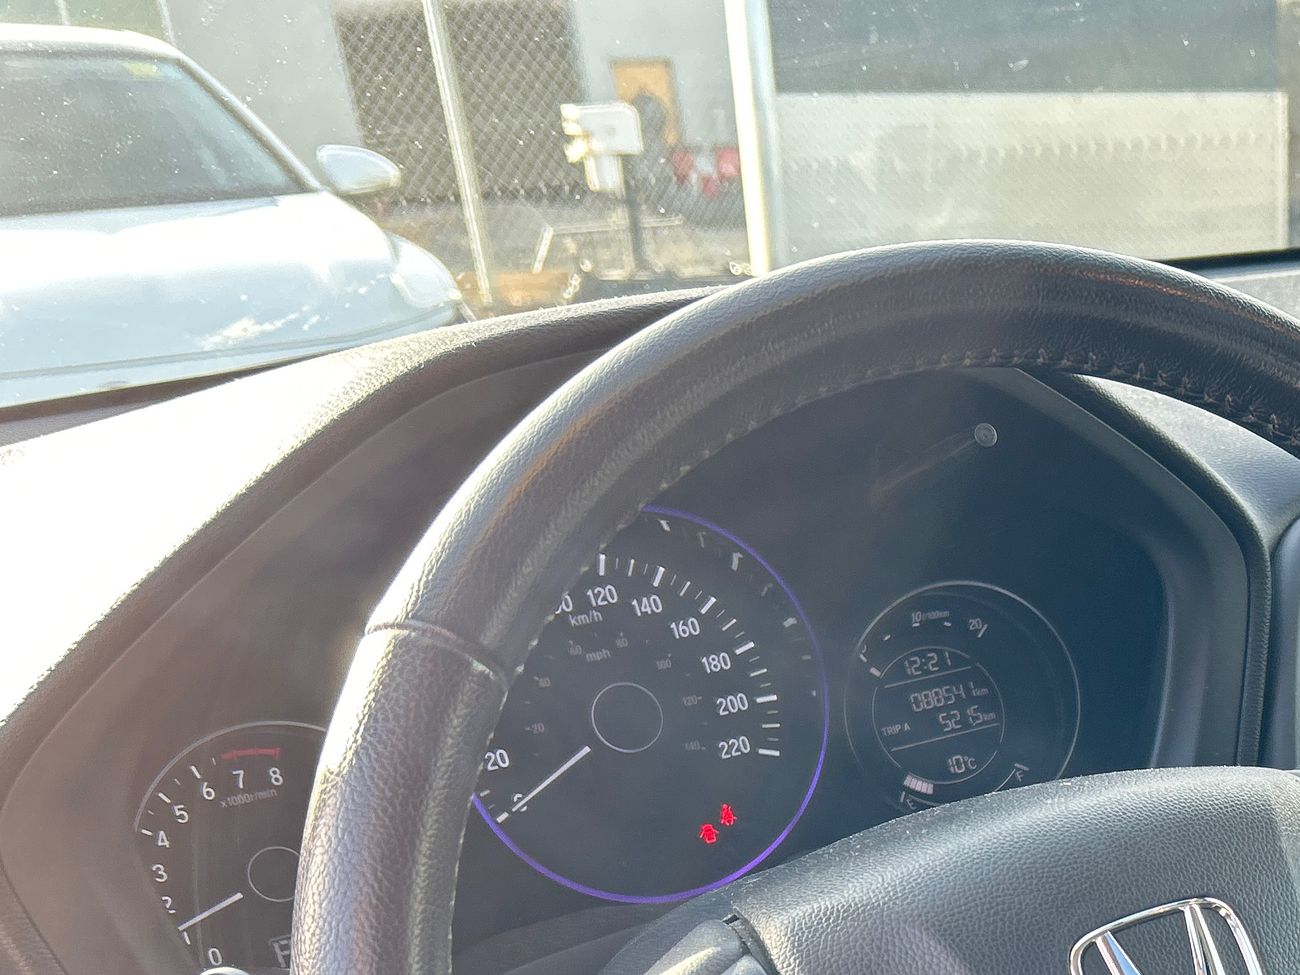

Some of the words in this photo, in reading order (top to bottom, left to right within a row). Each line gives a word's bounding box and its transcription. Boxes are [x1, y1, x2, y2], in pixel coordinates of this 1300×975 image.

[587, 584, 618, 607] 120
[632, 594, 663, 616] 140
[569, 610, 603, 627] km/h
[670, 617, 700, 639] 160
[586, 648, 611, 662] mph
[701, 652, 732, 674] 180
[904, 651, 951, 676] 12:21
[716, 693, 749, 716] 200
[881, 725, 900, 736] TRIP
[904, 722, 911, 731] A
[718, 735, 750, 760] 220
[484, 749, 510, 771] 20
[232, 770, 244, 788] 7
[269, 768, 283, 785] 8
[202, 782, 215, 800] 6
[174, 805, 188, 823] 5
[157, 831, 170, 847] 4
[152, 864, 168, 882] 3
[208, 948, 223, 966] 0
